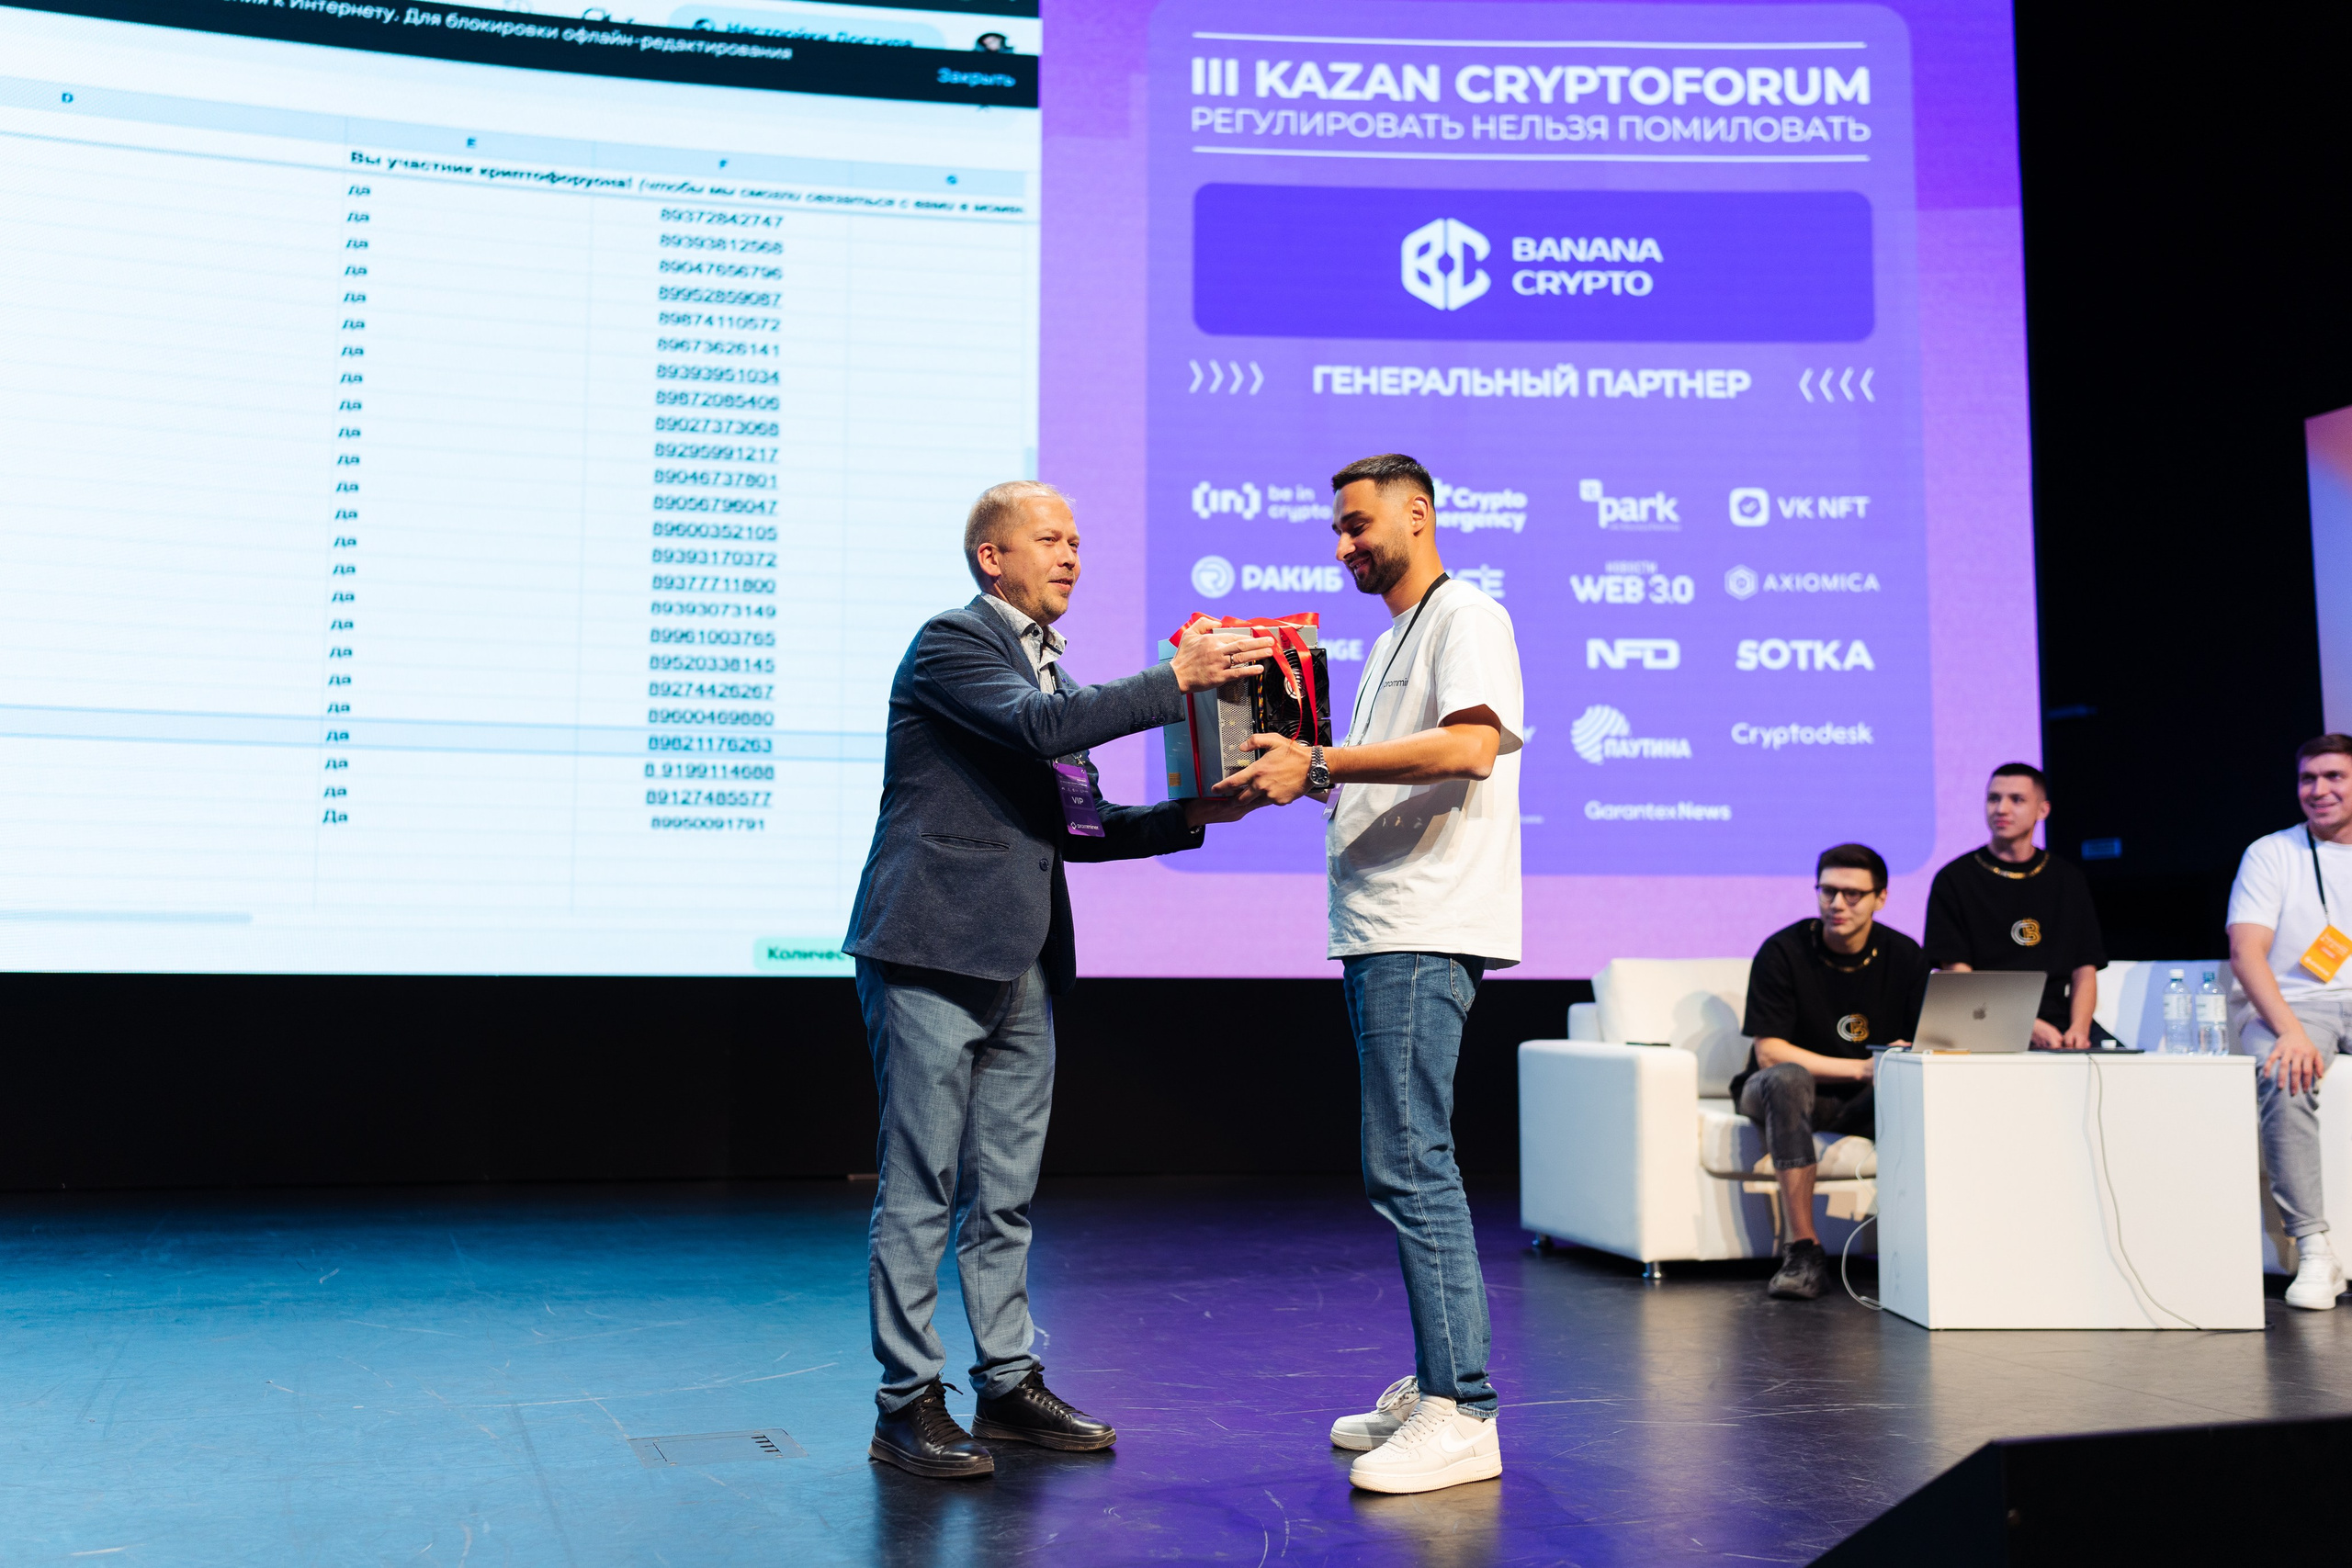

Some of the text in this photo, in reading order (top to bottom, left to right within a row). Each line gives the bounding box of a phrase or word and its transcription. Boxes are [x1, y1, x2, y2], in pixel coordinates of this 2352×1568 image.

[403, 7, 442, 27] Для
[445, 12, 559, 39] блокировки
[937, 67, 1016, 87] Закрыть
[1192, 57, 1871, 107] III KAZAN CRYPTOFORUM
[1192, 106, 1871, 143] РЕГУЛИРОВАТЬ НЕЛЬЗЯ ПОМИЛОВАТЬ
[350, 151, 381, 165] Вы
[387, 158, 474, 175] участник
[347, 185, 371, 197] да
[346, 211, 370, 223] да
[345, 239, 369, 250] да
[1512, 236, 1665, 264] BANANA
[344, 265, 368, 276] да
[1512, 269, 1655, 297] CRYPTO
[343, 292, 367, 303] да
[342, 319, 366, 331] да
[341, 345, 365, 357] да
[339, 373, 364, 384] да
[1313, 363, 1752, 399] ГЕНЕРАЛЬНЫЙ ПАРТНЕР
[338, 400, 363, 412] да
[337, 427, 362, 439] да
[336, 455, 361, 466] да
[335, 481, 360, 493] да
[1268, 483, 1316, 502] be in
[1453, 487, 1528, 513] Crypto
[1268, 503, 1333, 524] crypto
[1599, 491, 1680, 529] park
[1777, 496, 1871, 519] VK NFT
[334, 509, 358, 521] да
[1436, 511, 1526, 533] ergency
[334, 536, 357, 548] да
[332, 564, 356, 576] да
[1241, 565, 1344, 592] РАКИБ
[1762, 572, 1882, 592] AXIOMICA
[1569, 573, 1695, 604] WEB 3.0
[331, 592, 356, 604] да
[330, 619, 355, 631] да
[329, 647, 354, 659] да
[1586, 637, 1680, 670] NFD
[1736, 638, 1876, 671] SOTKA
[327, 674, 352, 686] да
[326, 703, 351, 714] да
[325, 730, 350, 743] да
[1731, 721, 1874, 751] Cryptodesk
[1603, 737, 1693, 759] ПАУТИНА
[324, 759, 349, 771] да
[323, 786, 348, 798] да
[1070, 796, 1084, 806] VIP
[322, 809, 349, 825] Да
